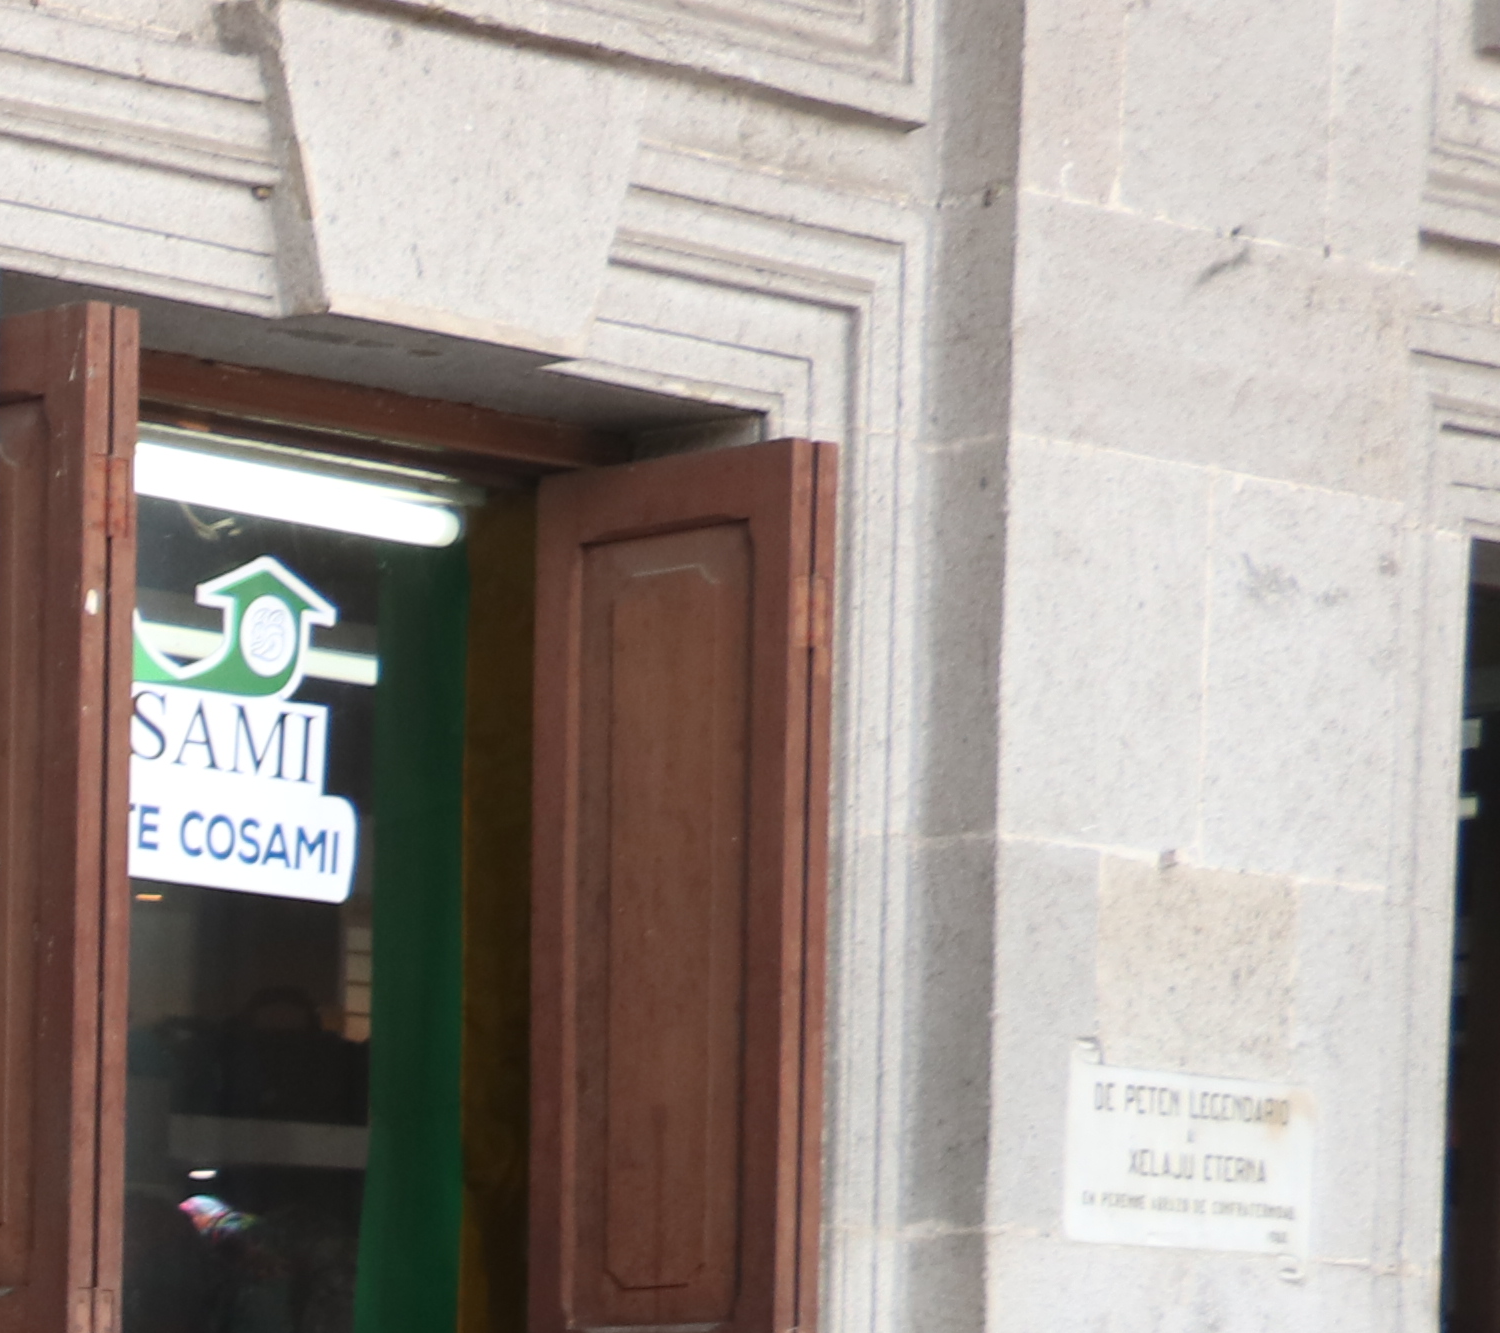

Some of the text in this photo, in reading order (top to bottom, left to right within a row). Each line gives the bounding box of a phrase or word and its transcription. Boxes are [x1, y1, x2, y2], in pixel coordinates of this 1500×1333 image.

[130, 690, 318, 785] SAMI
[129, 803, 340, 876] E COSAMI
[1094, 1081, 1116, 1112] DE
[1188, 1088, 1290, 1127] LEGENDARIO
[1129, 1148, 1267, 1183] XELAJU ETERNA
